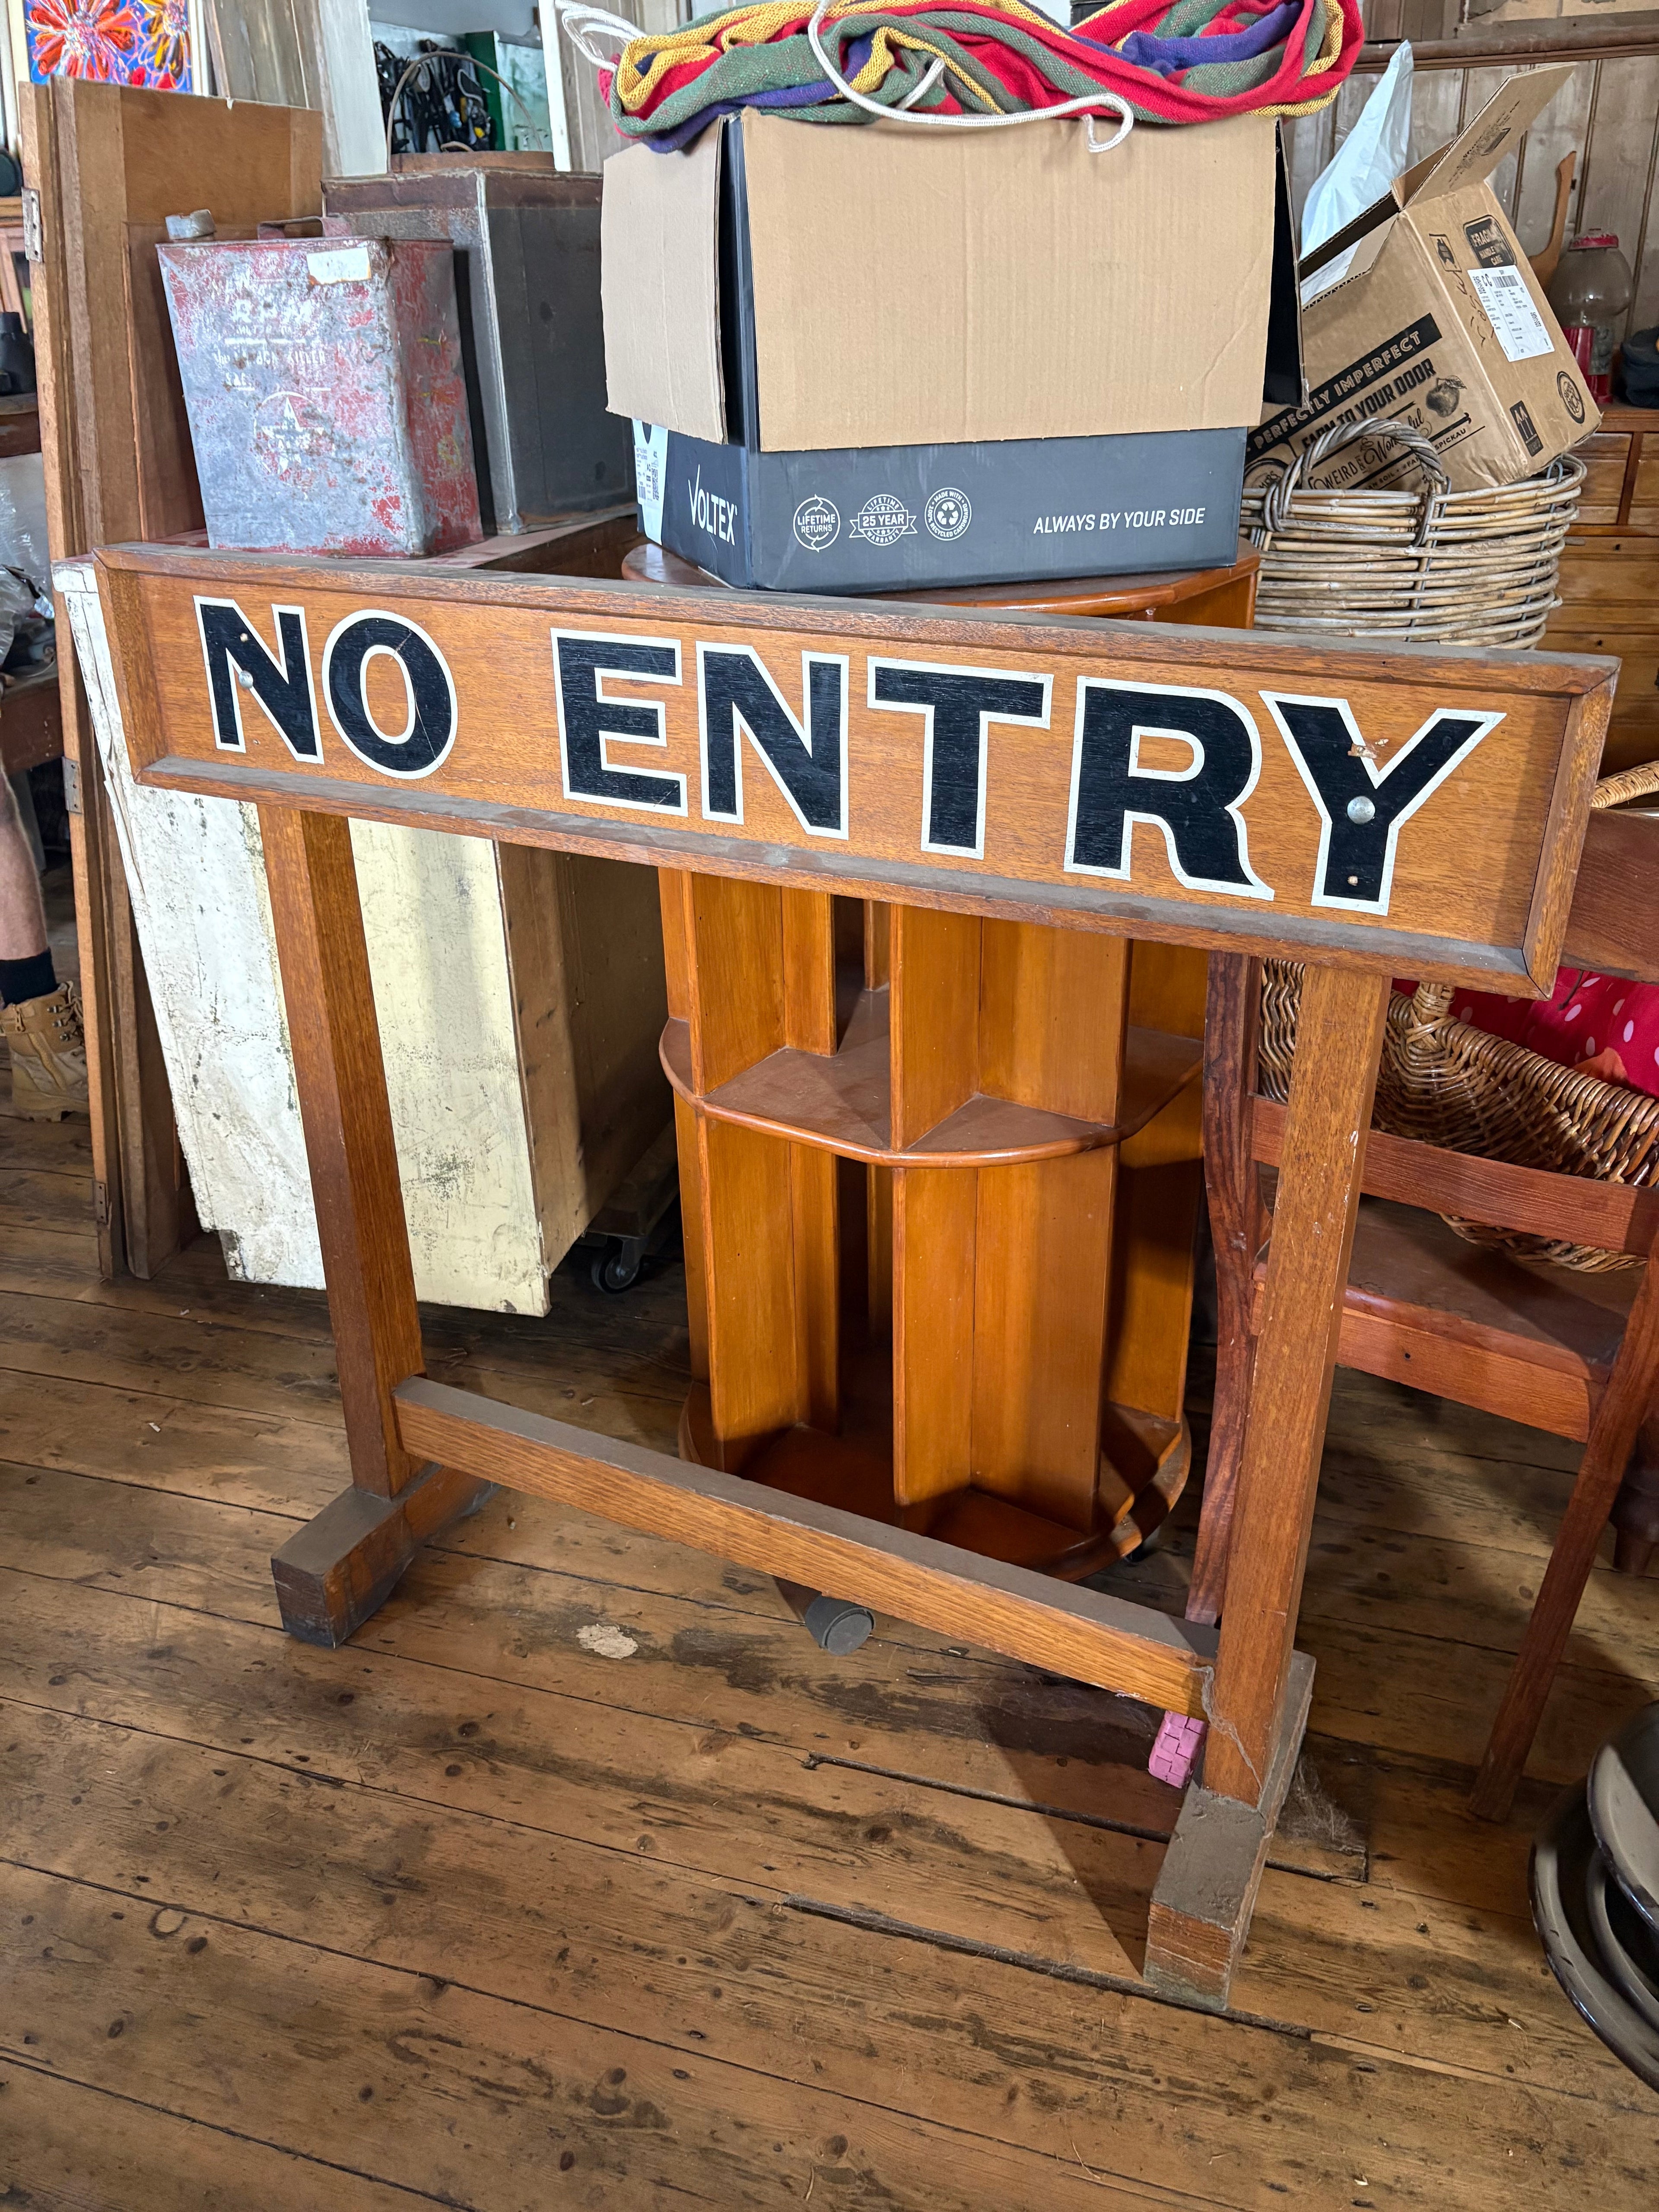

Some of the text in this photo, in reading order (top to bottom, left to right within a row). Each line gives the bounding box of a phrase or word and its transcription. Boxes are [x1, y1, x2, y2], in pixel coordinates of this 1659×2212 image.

[1254, 331, 1421, 449] PERFECTLY IMPERFECT
[1337, 408, 1357, 425] TO
[1354, 384, 1397, 419] YOUR
[1394, 358, 1437, 397] DOOR
[688, 464, 735, 546] VOLTEX
[867, 497, 899, 511] LIFETIME
[934, 491, 963, 502] MADE WITH
[797, 514, 836, 525] LIFETIME
[801, 524, 833, 534] RETURNS
[862, 514, 905, 527] 25 YEAR
[930, 522, 953, 537] RECYCLED
[953, 503, 969, 535] CARDBOARD
[1033, 508, 1206, 534] ALWAYS BY YOUR SIDE
[867, 529, 900, 543] WARRANTY
[193, 595, 1506, 917] NO ENTRY
